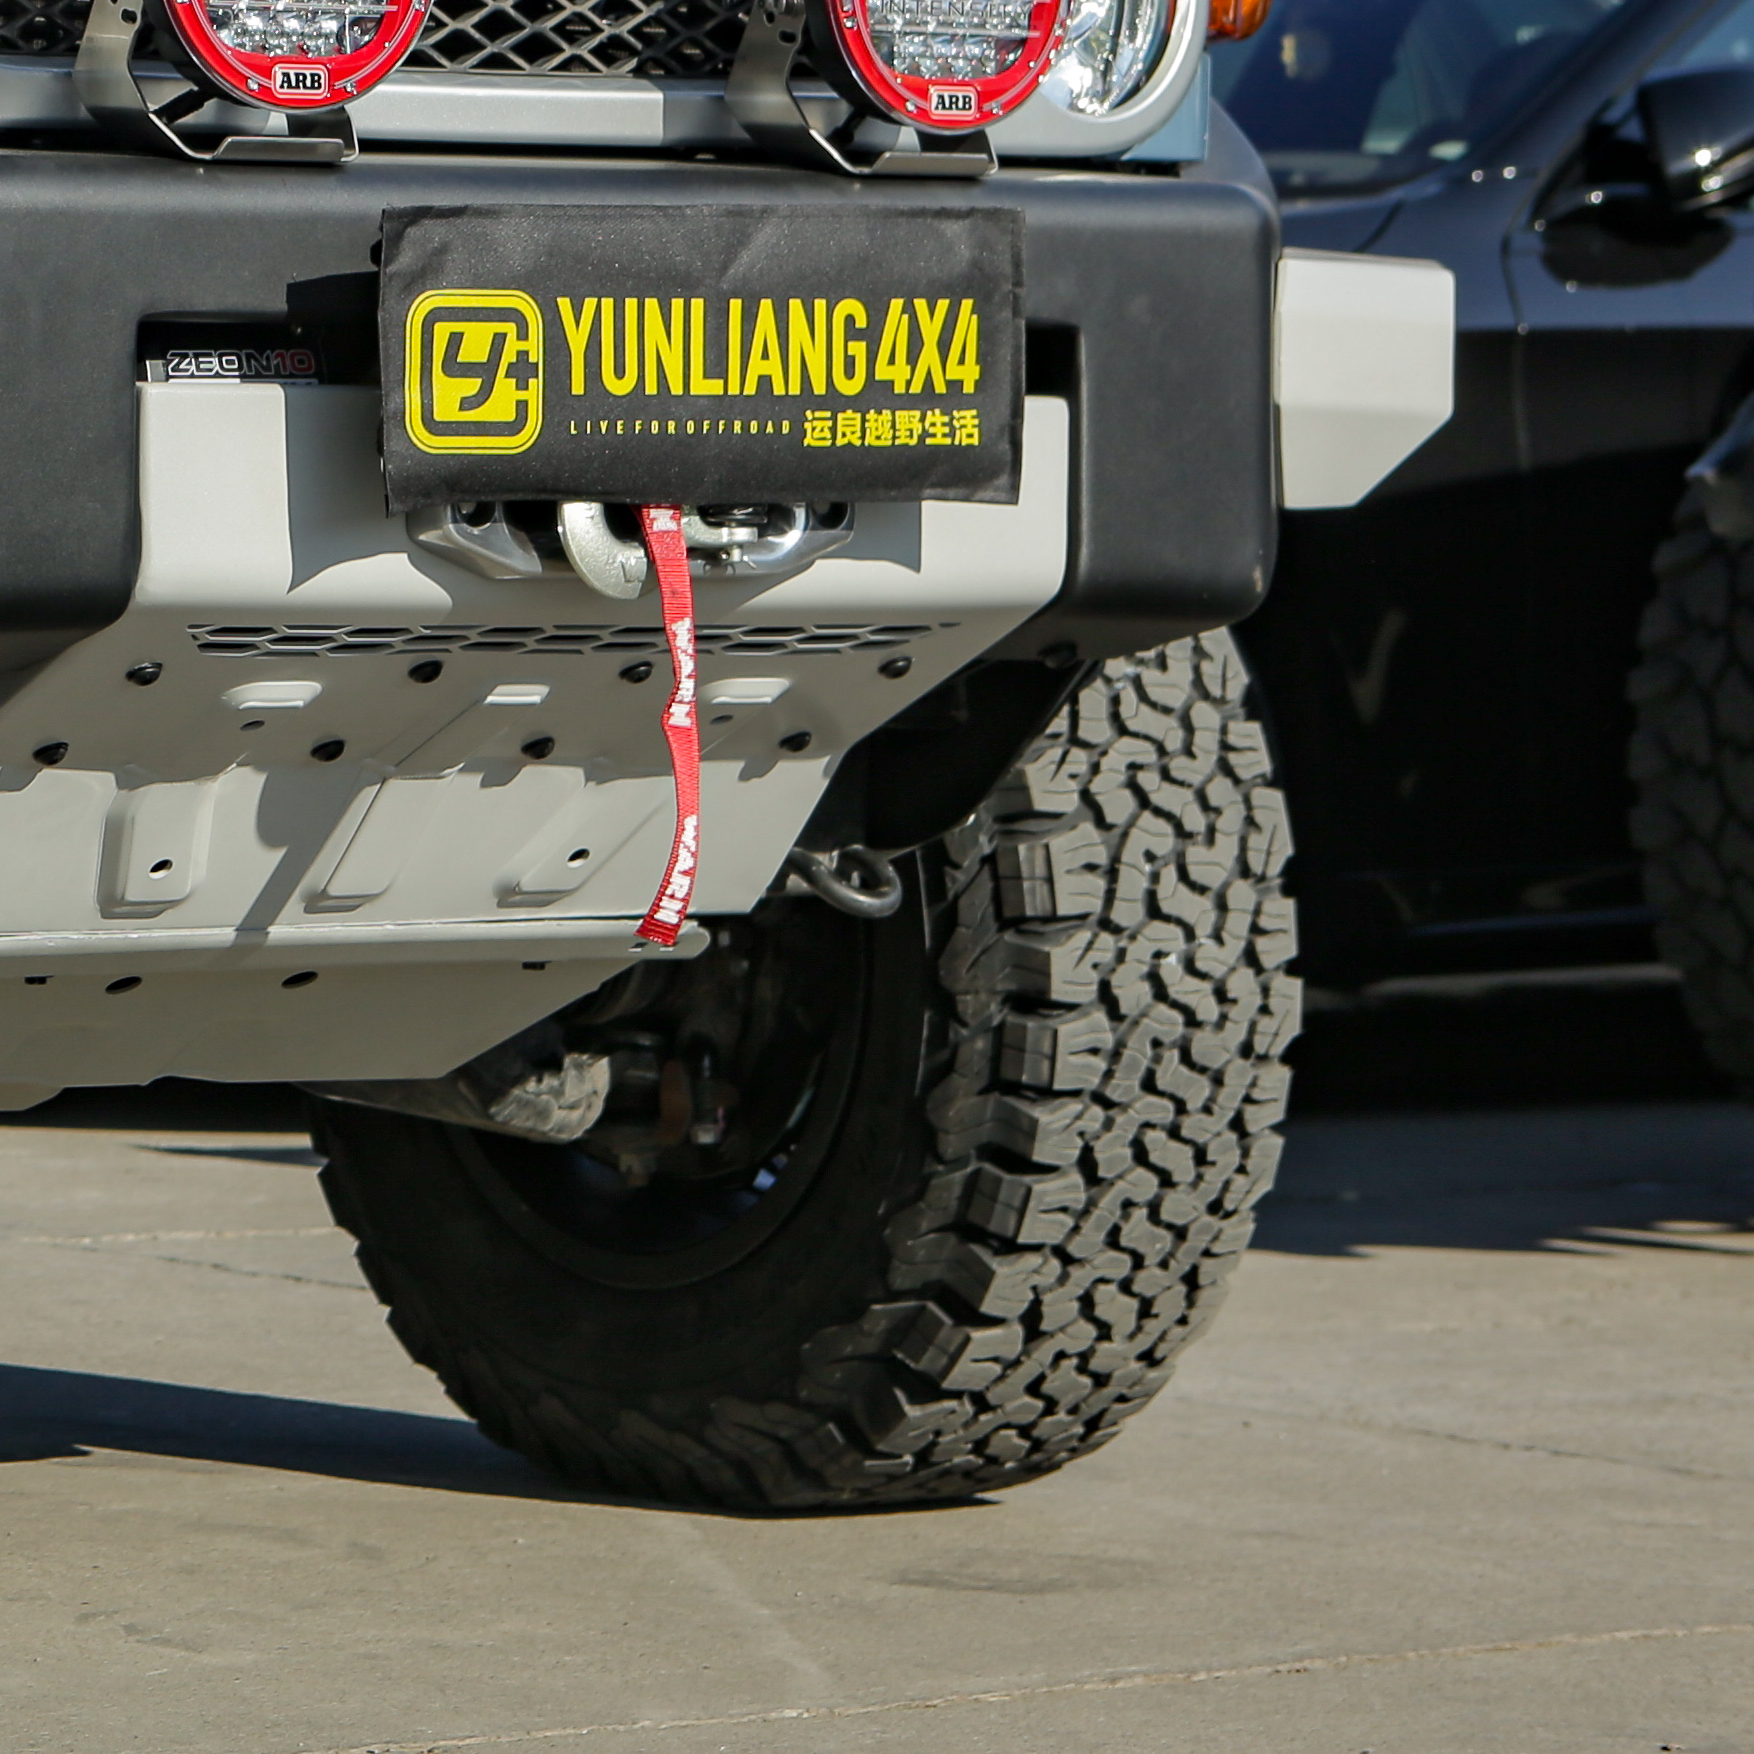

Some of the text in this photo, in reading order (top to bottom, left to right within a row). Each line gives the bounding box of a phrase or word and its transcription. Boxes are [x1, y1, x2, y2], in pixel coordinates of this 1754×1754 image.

[279, 71, 322, 90] ARB
[934, 94, 972, 111] ARB
[555, 297, 981, 397] YUNLIANG 4X4
[570, 419, 792, 436] LIVE FOR OFFROAD
[802, 408, 981, 447] 运良越野生活
[653, 813, 698, 926] WARN
